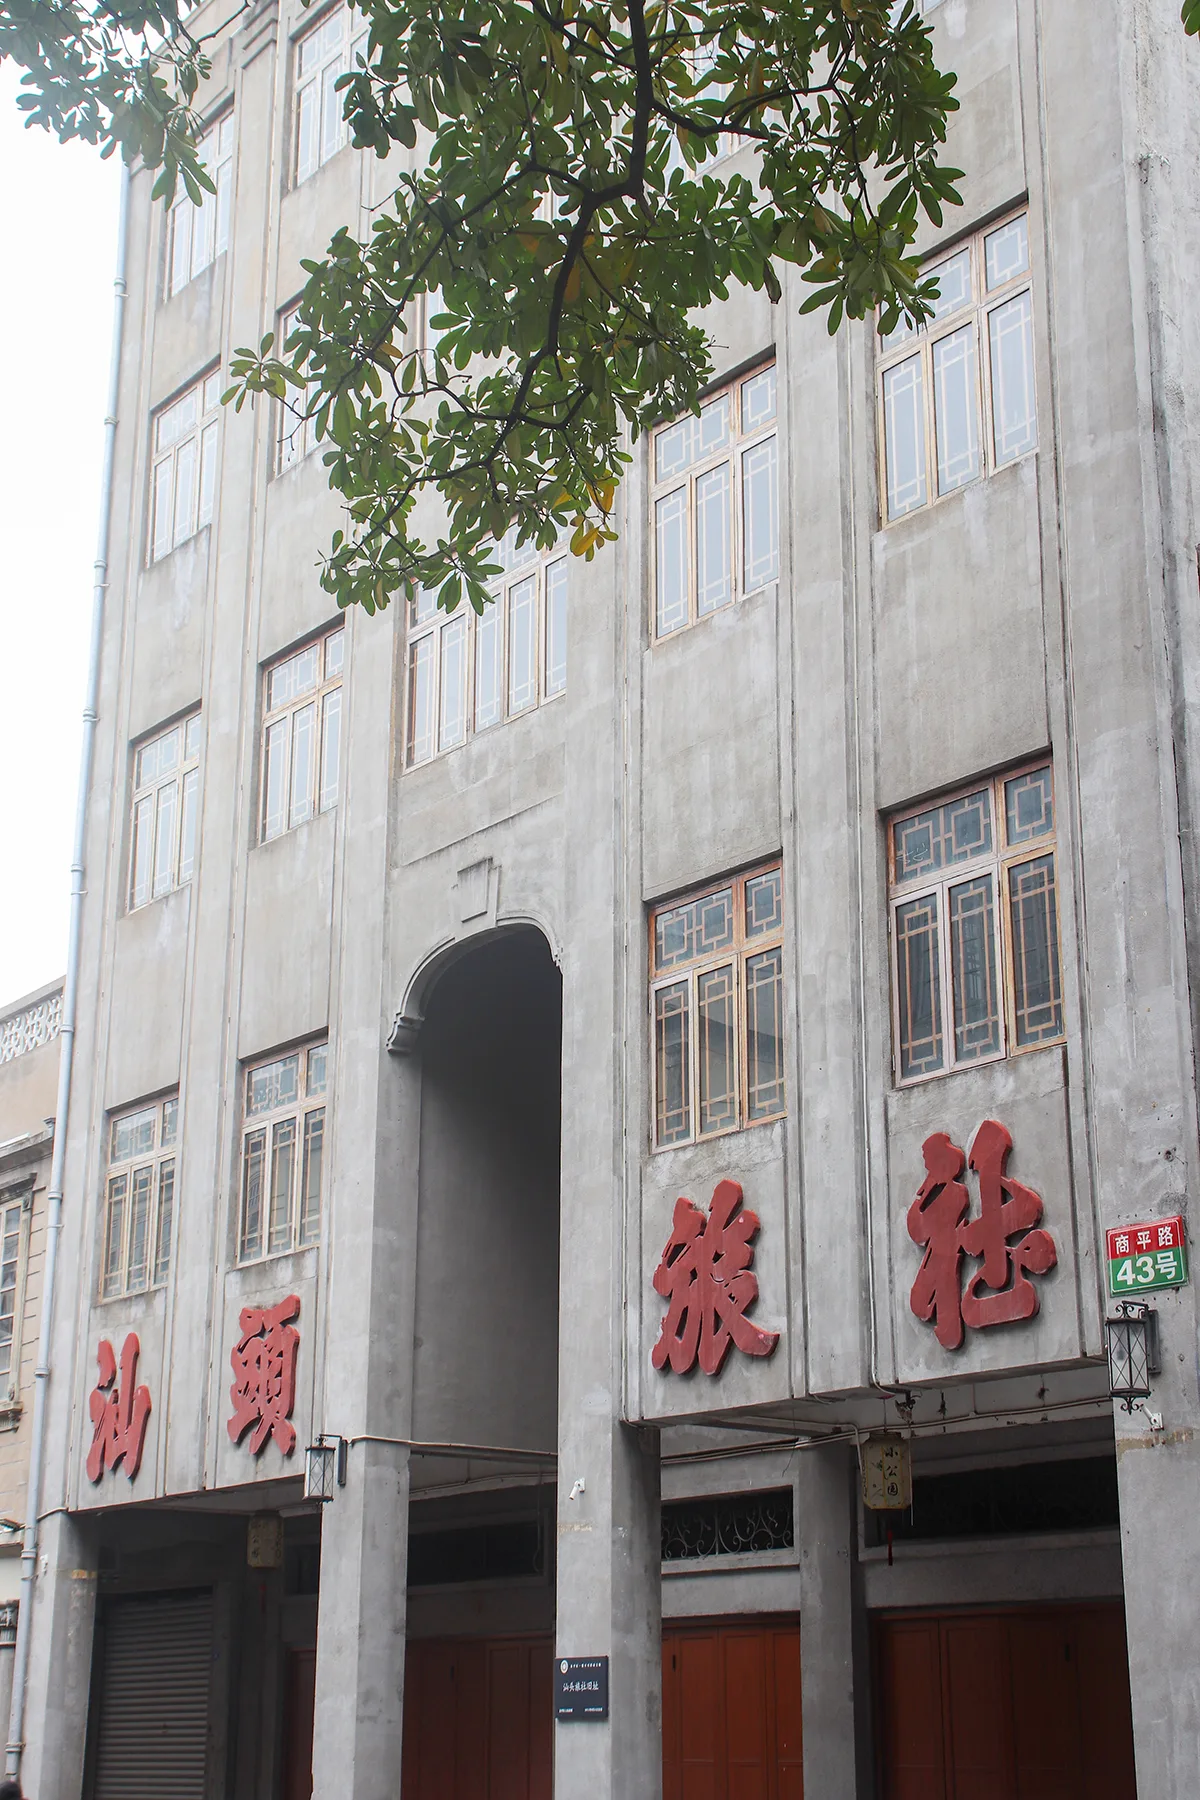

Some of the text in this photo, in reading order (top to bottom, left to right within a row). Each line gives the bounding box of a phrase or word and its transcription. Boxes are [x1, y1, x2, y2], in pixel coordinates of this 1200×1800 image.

[1115, 1226, 1174, 1254] 商平路
[1117, 1251, 1177, 1285] 43号
